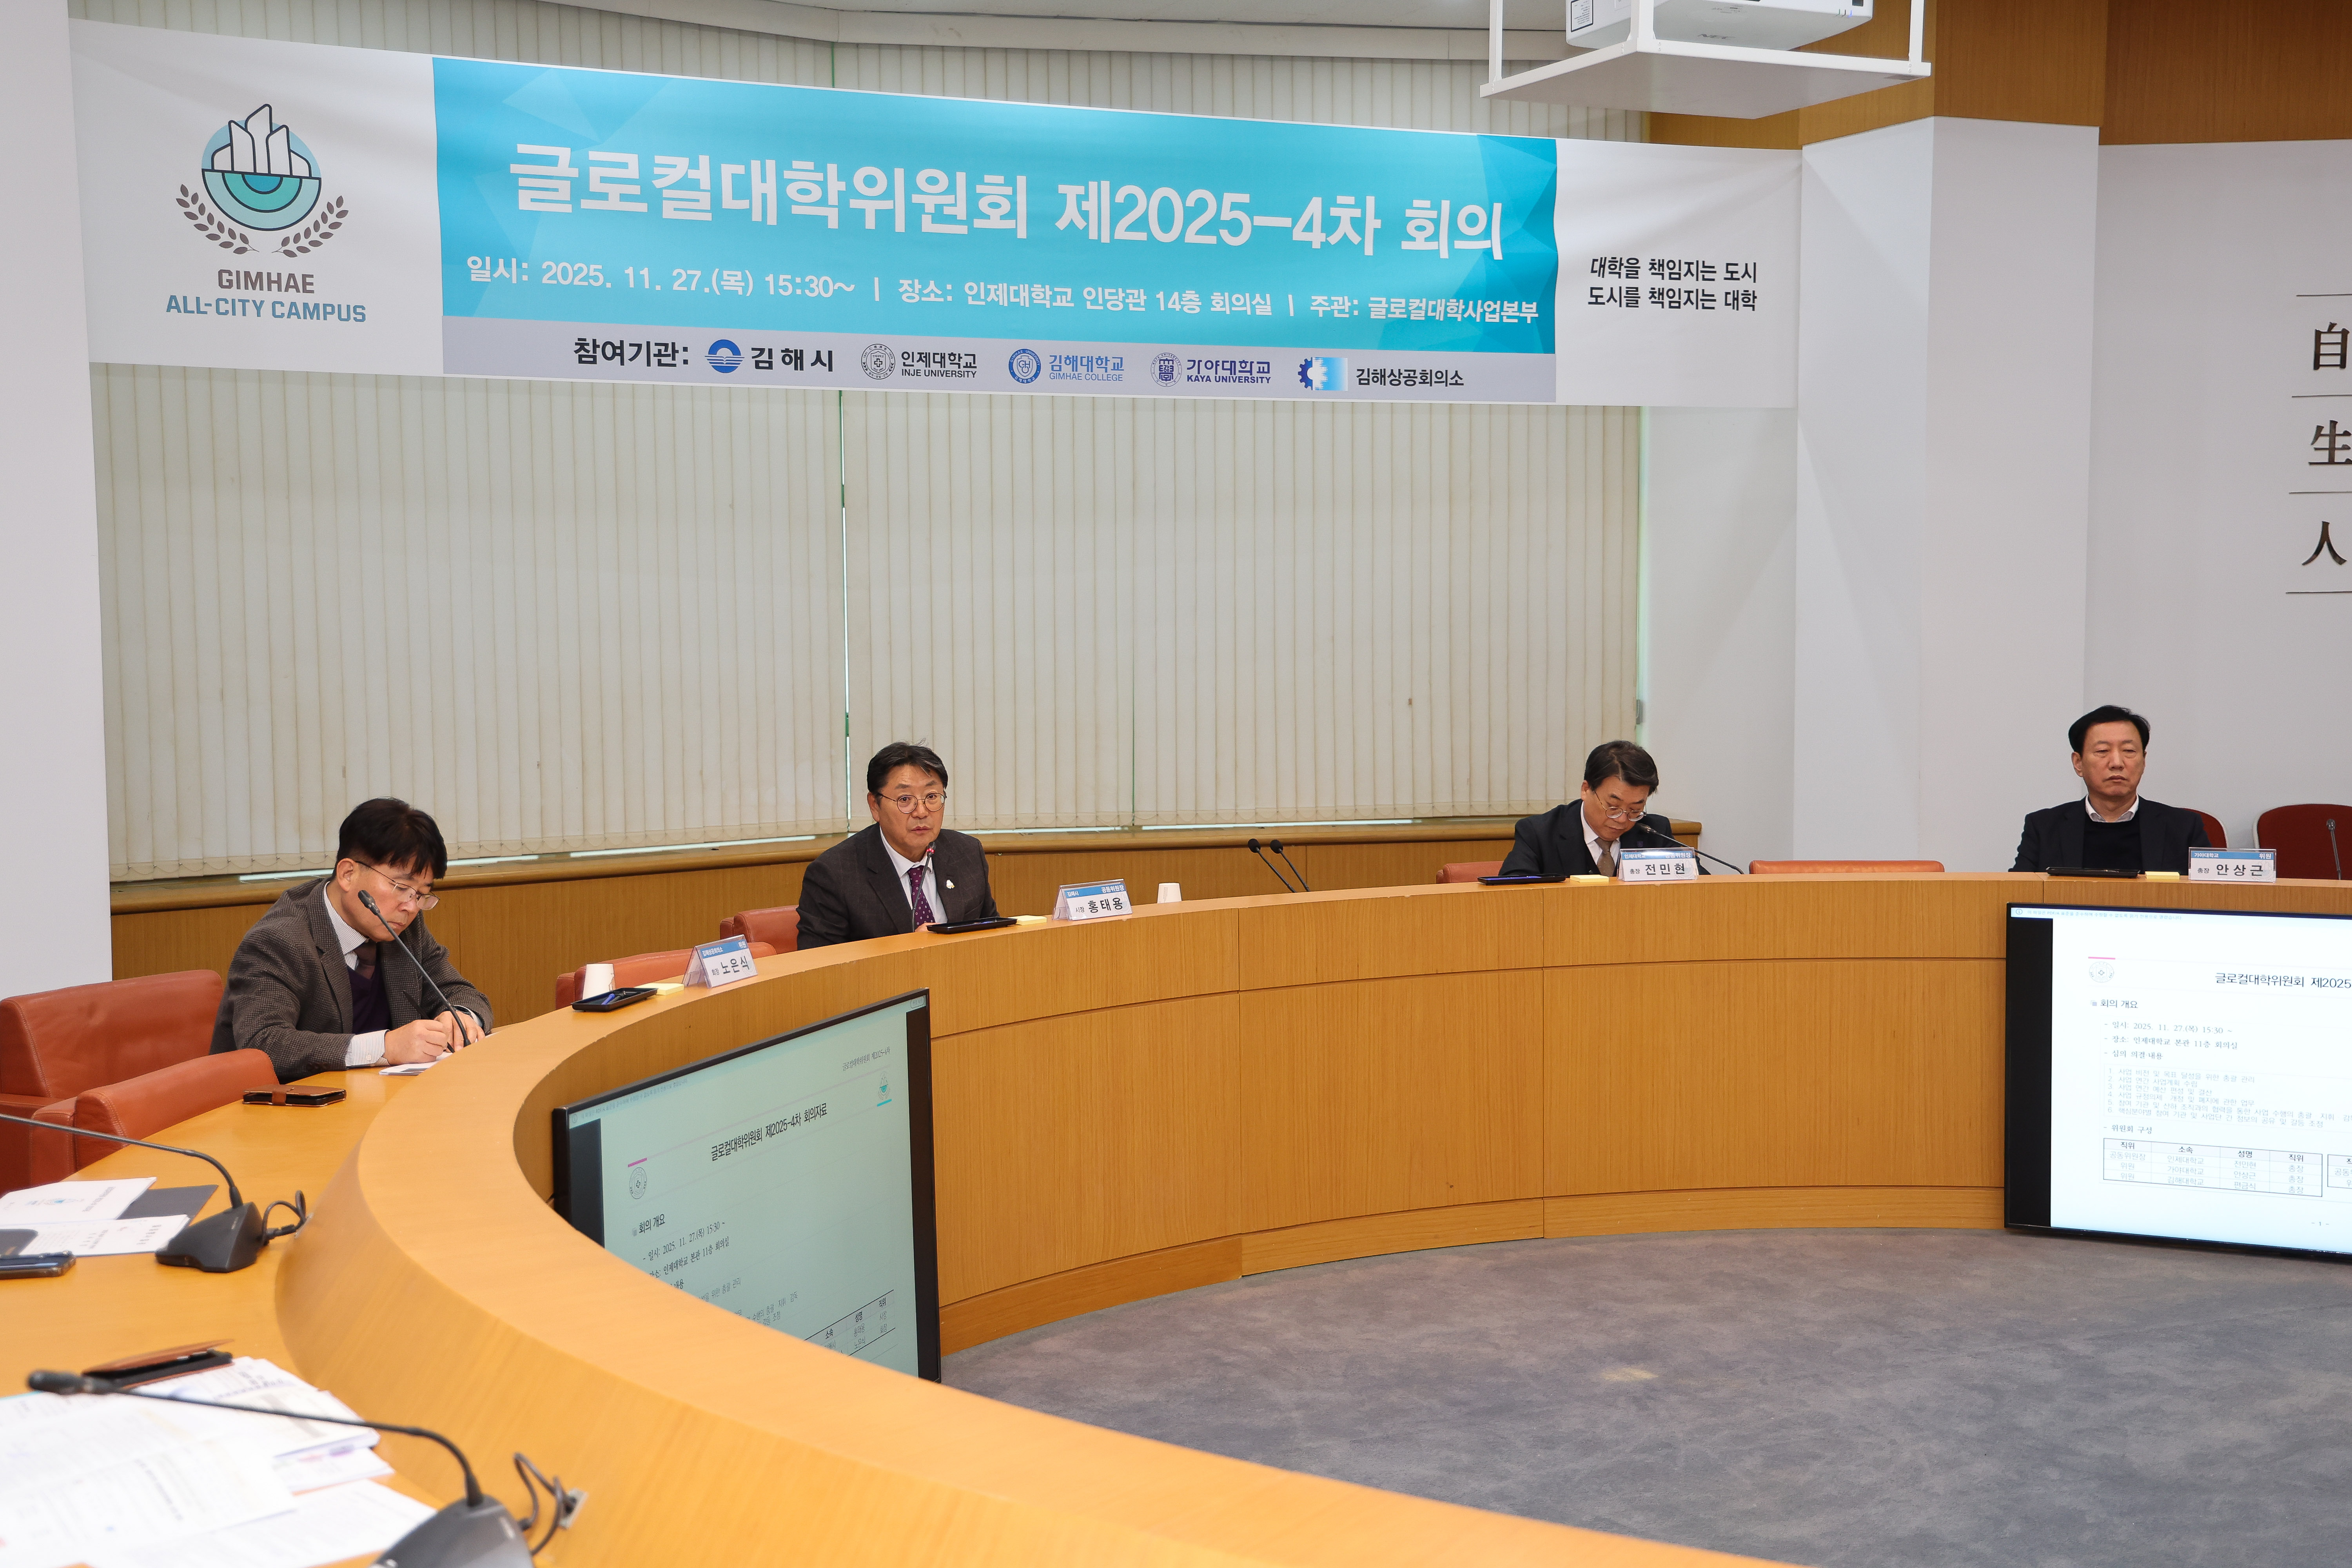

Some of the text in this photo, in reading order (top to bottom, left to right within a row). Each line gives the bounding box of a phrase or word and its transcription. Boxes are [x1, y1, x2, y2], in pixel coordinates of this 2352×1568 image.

[510, 144, 1503, 260] 글로컬대학위원회 제2025-4차 회의
[1591, 257, 1756, 283] 대학을 책임지는 도시
[218, 269, 314, 293] GIMHAE
[467, 256, 1538, 323] 일시: 2025. 11. 27.(목) 15:30~ 장소: 인제대학교 인당관 14층 회의실 주관: 글로컬대학사업본부
[1588, 286, 1757, 311] 도시를 책임지는 대학
[166, 295, 365, 322] ALL-CITY CAMPUS
[574, 338, 688, 367] 참여기관:
[2314, 322, 2350, 370] 自
[901, 351, 977, 369] 인제대학교
[1049, 354, 1124, 373] 김해대학교
[1186, 359, 1270, 376] 가야대학교
[924, 369, 977, 378] UNIVERSITY
[1214, 376, 1271, 384] UNIVERSITY
[1356, 368, 1464, 387] 김해상공회의소
[2309, 420, 2352, 465] 生
[2302, 521, 2347, 566] 人
[1645, 863, 1685, 875] 전민현
[2216, 864, 2263, 877] 안상근
[1101, 884, 1124, 893] 공동위원장
[1088, 897, 1123, 913] 홍태용
[702, 940, 747, 957] 김해상공회의소 위원
[721, 955, 750, 975] 노은식
[2216, 973, 2304, 987] 글로컬대학위원회
[2100, 999, 2117, 1008] 회의
[2134, 1037, 2170, 1045] 인제대학교
[2215, 1041, 2238, 1050] 회의실
[711, 1103, 828, 1161] 글로컬대학위원회 제2025-4차 회의자료
[2109, 1151, 2303, 1173] 공동위원장 인제대학교 전민현 총장
[2167, 1166, 2204, 1175] 가야대학교
[2234, 1171, 2256, 1179] 안상근
[2288, 1175, 2303, 1183] 총장
[2168, 1176, 2204, 1185] 김해대학교
[2234, 1181, 2256, 1190] 편금식
[2289, 1185, 2303, 1194] 총장
[639, 1214, 665, 1233] 회의 개요
[648, 1248, 660, 1261] 일시:
[663, 1241, 676, 1254] 2025.
[689, 1228, 704, 1242] 27.(목)
[707, 1221, 720, 1234] 15:30
[664, 1236, 729, 1275] 인제대학교 본관 11층 회의실
[826, 1297, 886, 1339] 소속 성명 직위
